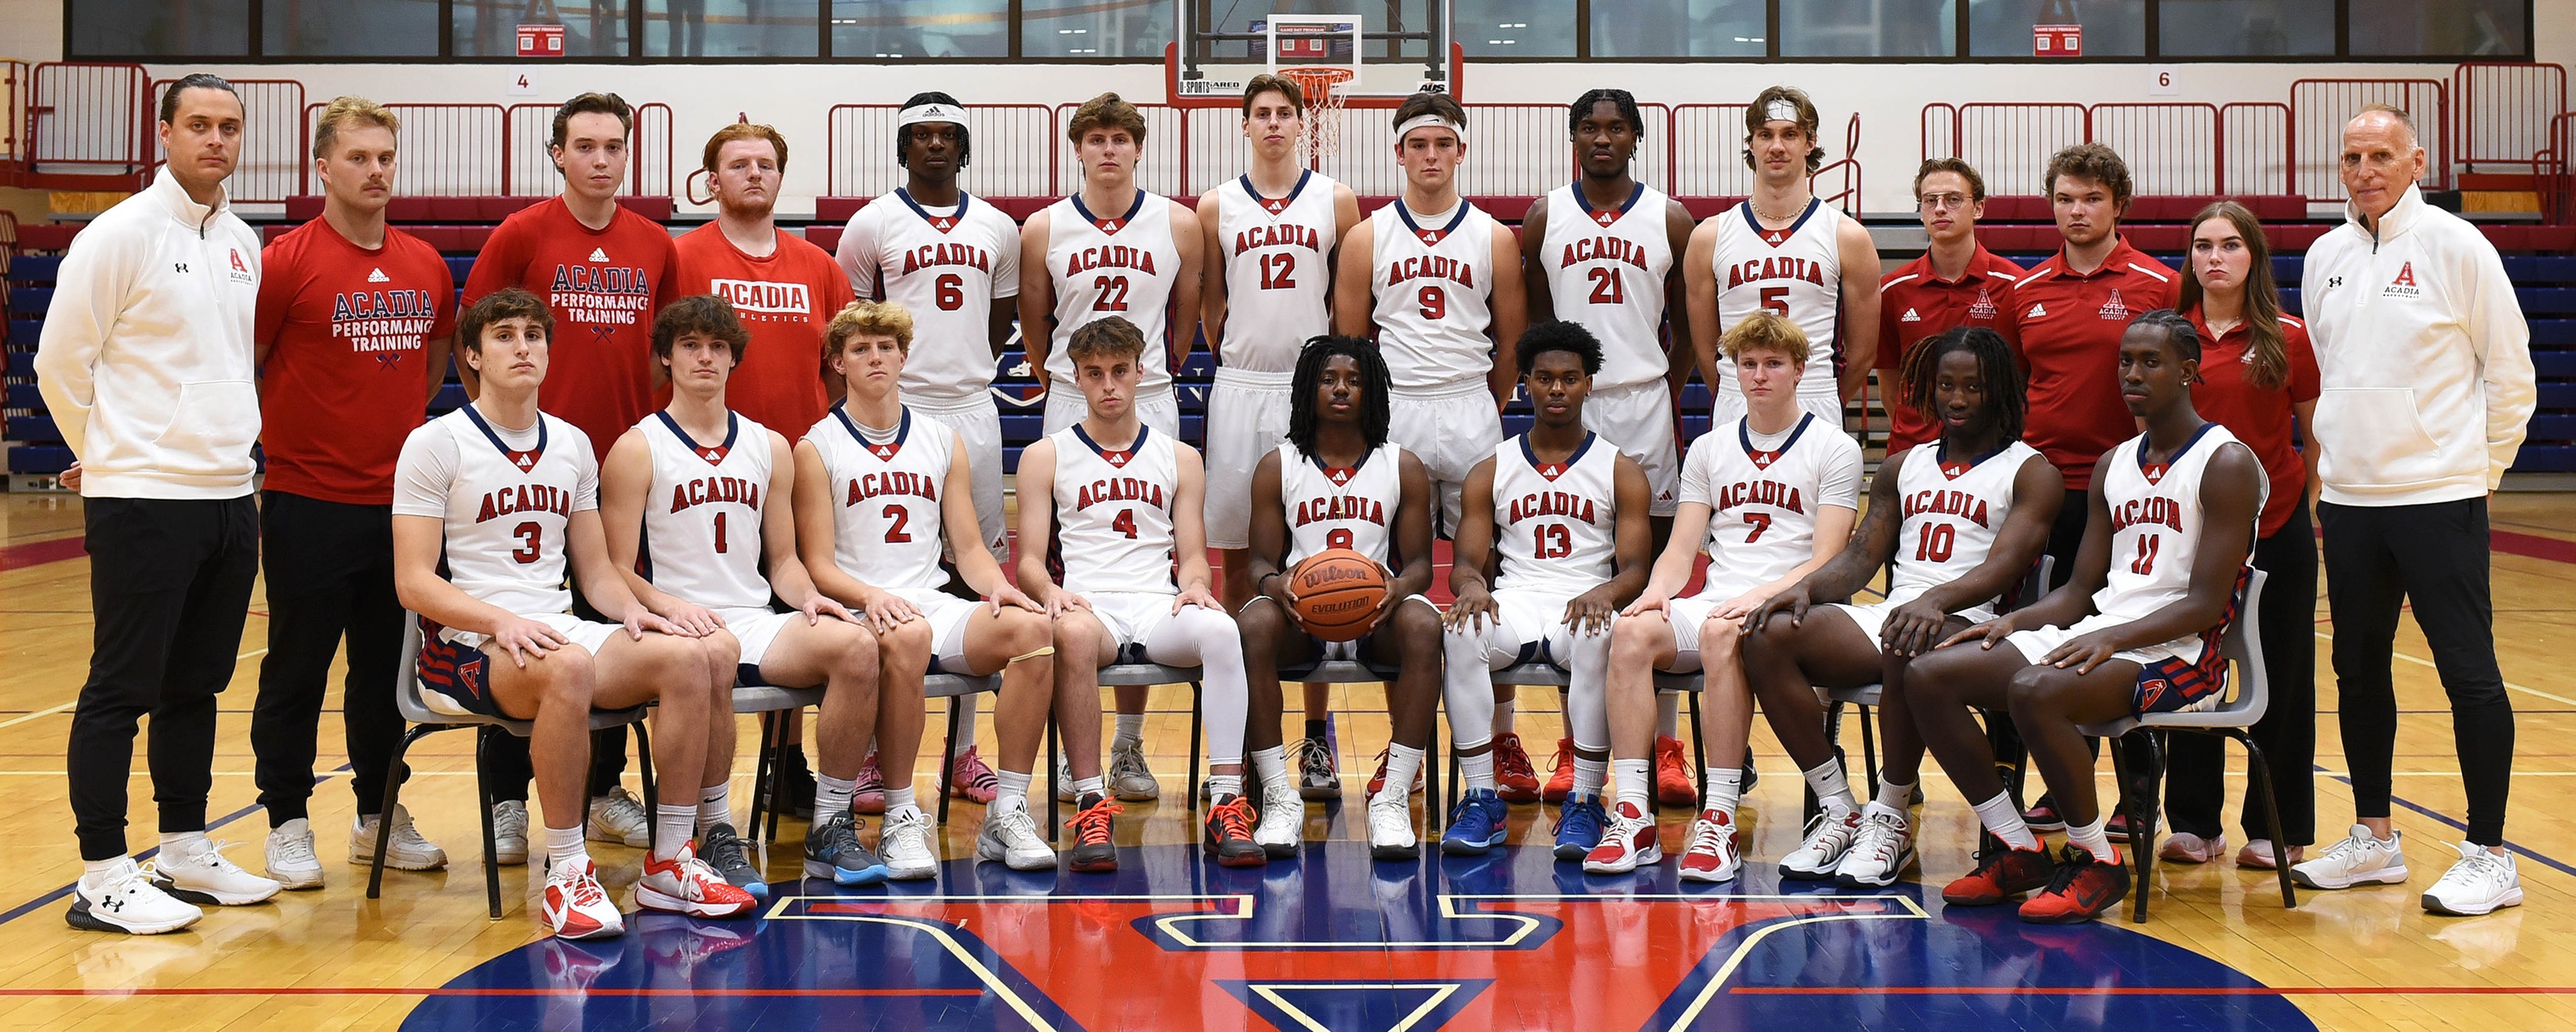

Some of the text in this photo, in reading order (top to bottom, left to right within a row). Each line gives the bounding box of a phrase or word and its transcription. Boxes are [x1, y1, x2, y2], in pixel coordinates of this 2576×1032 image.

[517, 74, 528, 88] 4
[2159, 71, 2170, 87] 6
[1235, 224, 1320, 257] ACADIA
[1561, 237, 1647, 273] ACADIA
[902, 244, 989, 276] ACADIA
[1067, 245, 1156, 278] ACADIA
[1260, 253, 1296, 290] 12
[1388, 256, 1474, 290] ACADIA
[1728, 257, 1823, 290] ACADIA
[230, 272, 252, 282] ACADIA
[550, 263, 649, 296] ACADIA
[936, 274, 962, 311] 6
[1093, 276, 1128, 311] 22
[1588, 268, 1623, 304] 21
[2384, 286, 2420, 295] ACADIA
[332, 290, 435, 322] ACADIA
[719, 282, 805, 309] ACADIA
[1418, 286, 1445, 319] 9
[1760, 287, 1790, 318] 5
[568, 308, 635, 324] TRAINING
[741, 313, 808, 323] HLETICS
[352, 335, 421, 352] TRAINING
[476, 484, 572, 523] ACADIA
[671, 477, 758, 515] ACADIA
[847, 472, 936, 507] ACADIA
[1077, 477, 1162, 513] ACADIA
[1719, 480, 1804, 515] ACADIA
[882, 505, 911, 543] 2
[1113, 509, 1137, 539] 4
[1296, 495, 1384, 527] ACADIA
[1509, 491, 1595, 527] ACADIA
[1904, 490, 1988, 529] ACADIA
[513, 522, 542, 563] 3
[714, 512, 728, 553] 1
[1534, 524, 1571, 560] 13
[1743, 513, 1771, 543] 7
[1915, 522, 1955, 563] 10
[2131, 534, 2159, 575] 11
[1303, 565, 1369, 589] Wilson
[1311, 595, 1369, 613] EVOLUTION
